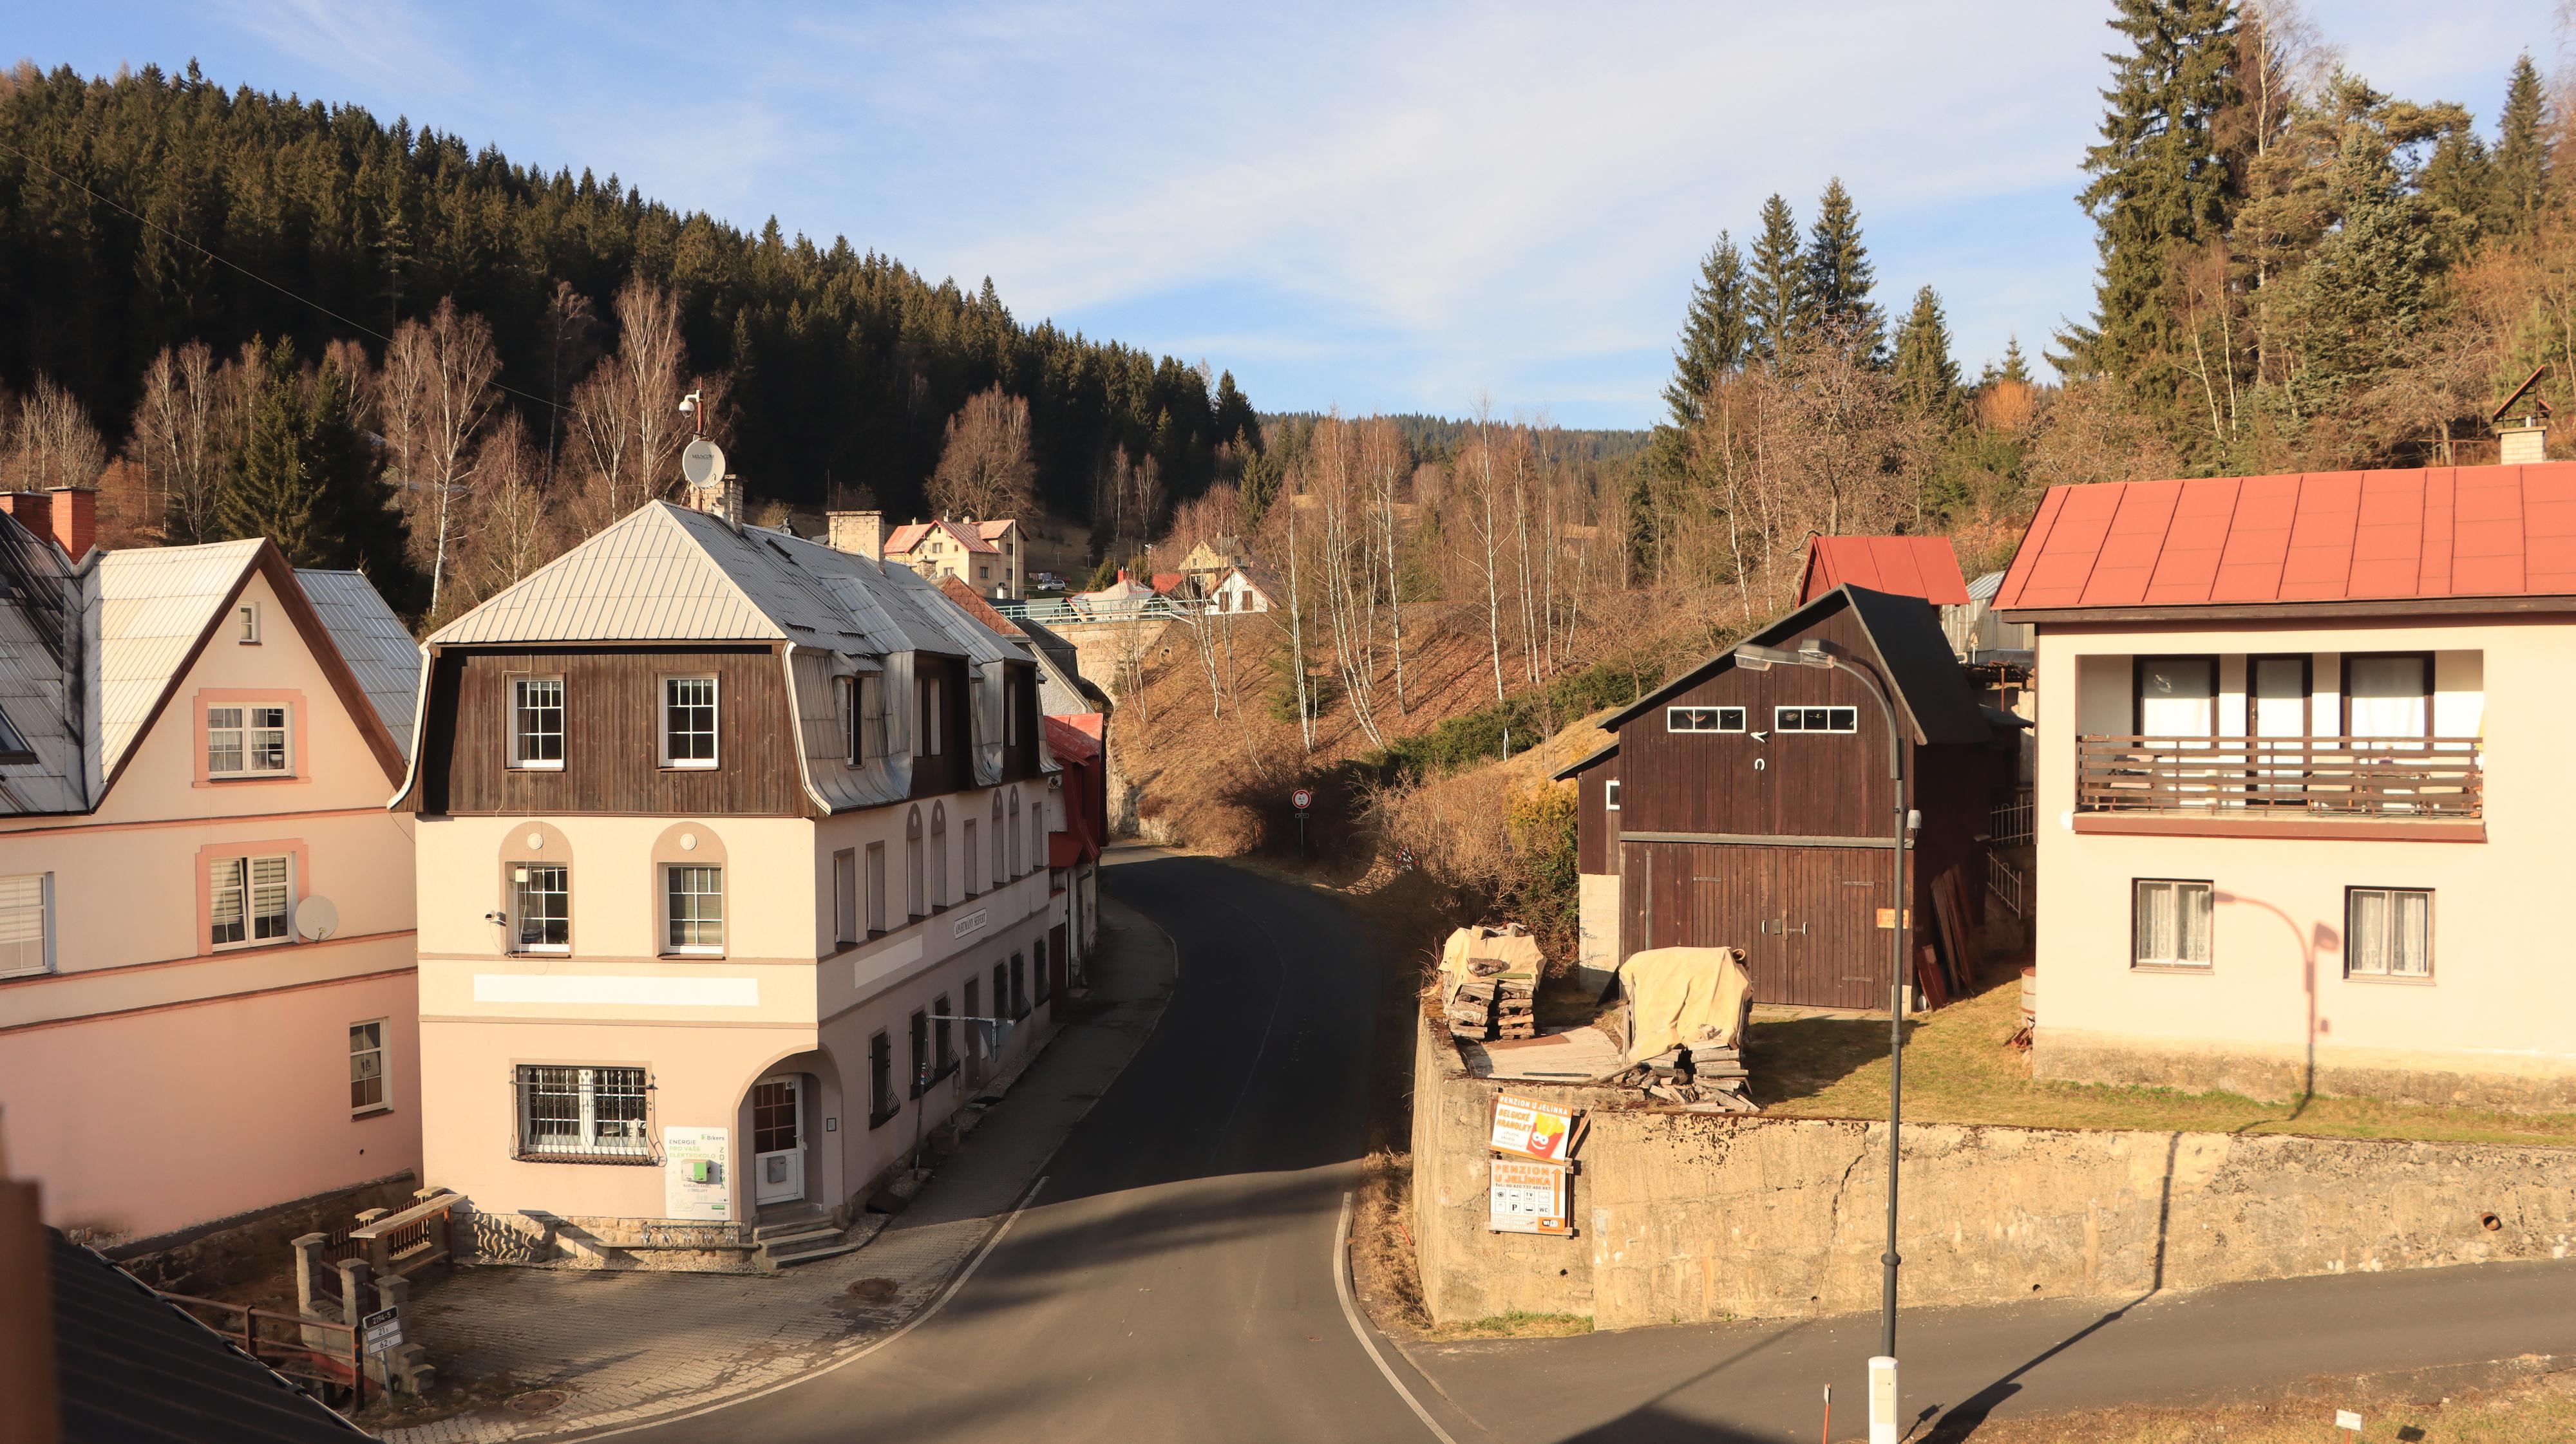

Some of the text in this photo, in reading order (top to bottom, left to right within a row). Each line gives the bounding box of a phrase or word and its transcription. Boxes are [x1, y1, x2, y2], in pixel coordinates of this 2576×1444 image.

[1500, 1096, 1530, 1107] PENZION
[1539, 1103, 1567, 1115] JELÍNKA
[1498, 1108, 1531, 1121] BELGICKÉ
[1496, 1119, 1531, 1133] HRANOLKY
[1495, 1164, 1549, 1176] PENZION
[1504, 1174, 1551, 1186] JELÍNKA
[372, 1311, 392, 1324] 2194-5
[378, 1327, 386, 1336] 21
[380, 1339, 388, 1349] 62
